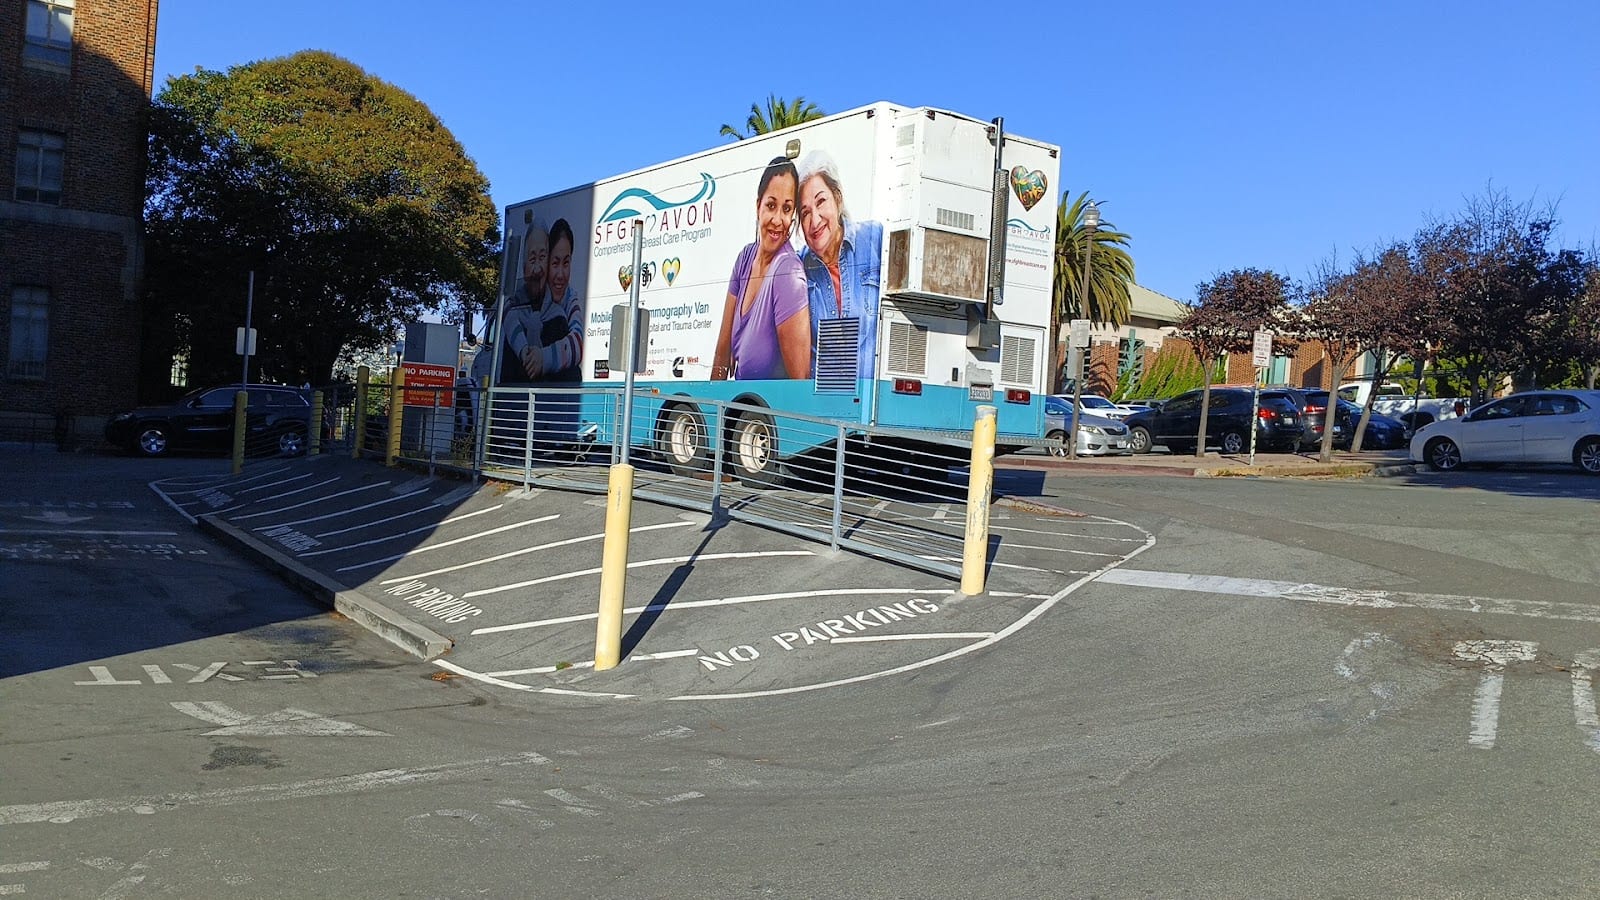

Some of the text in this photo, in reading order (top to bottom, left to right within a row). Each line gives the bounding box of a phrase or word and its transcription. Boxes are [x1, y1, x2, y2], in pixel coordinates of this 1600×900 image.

[659, 200, 713, 232] AVON
[641, 235, 662, 249] Breast
[663, 232, 680, 246] Care
[681, 227, 712, 243] Program
[591, 301, 710, 324] Mobile mmography Van
[587, 328, 597, 337] San
[597, 327, 611, 336] Franc
[660, 322, 671, 332] and
[672, 320, 692, 331] Trauma
[692, 319, 712, 330] Center
[404, 367, 451, 378] NO PARKING
[383, 579, 482, 623] NO PARKING
[697, 598, 940, 671] NO PARKING
[73, 659, 320, 686] EXIT
